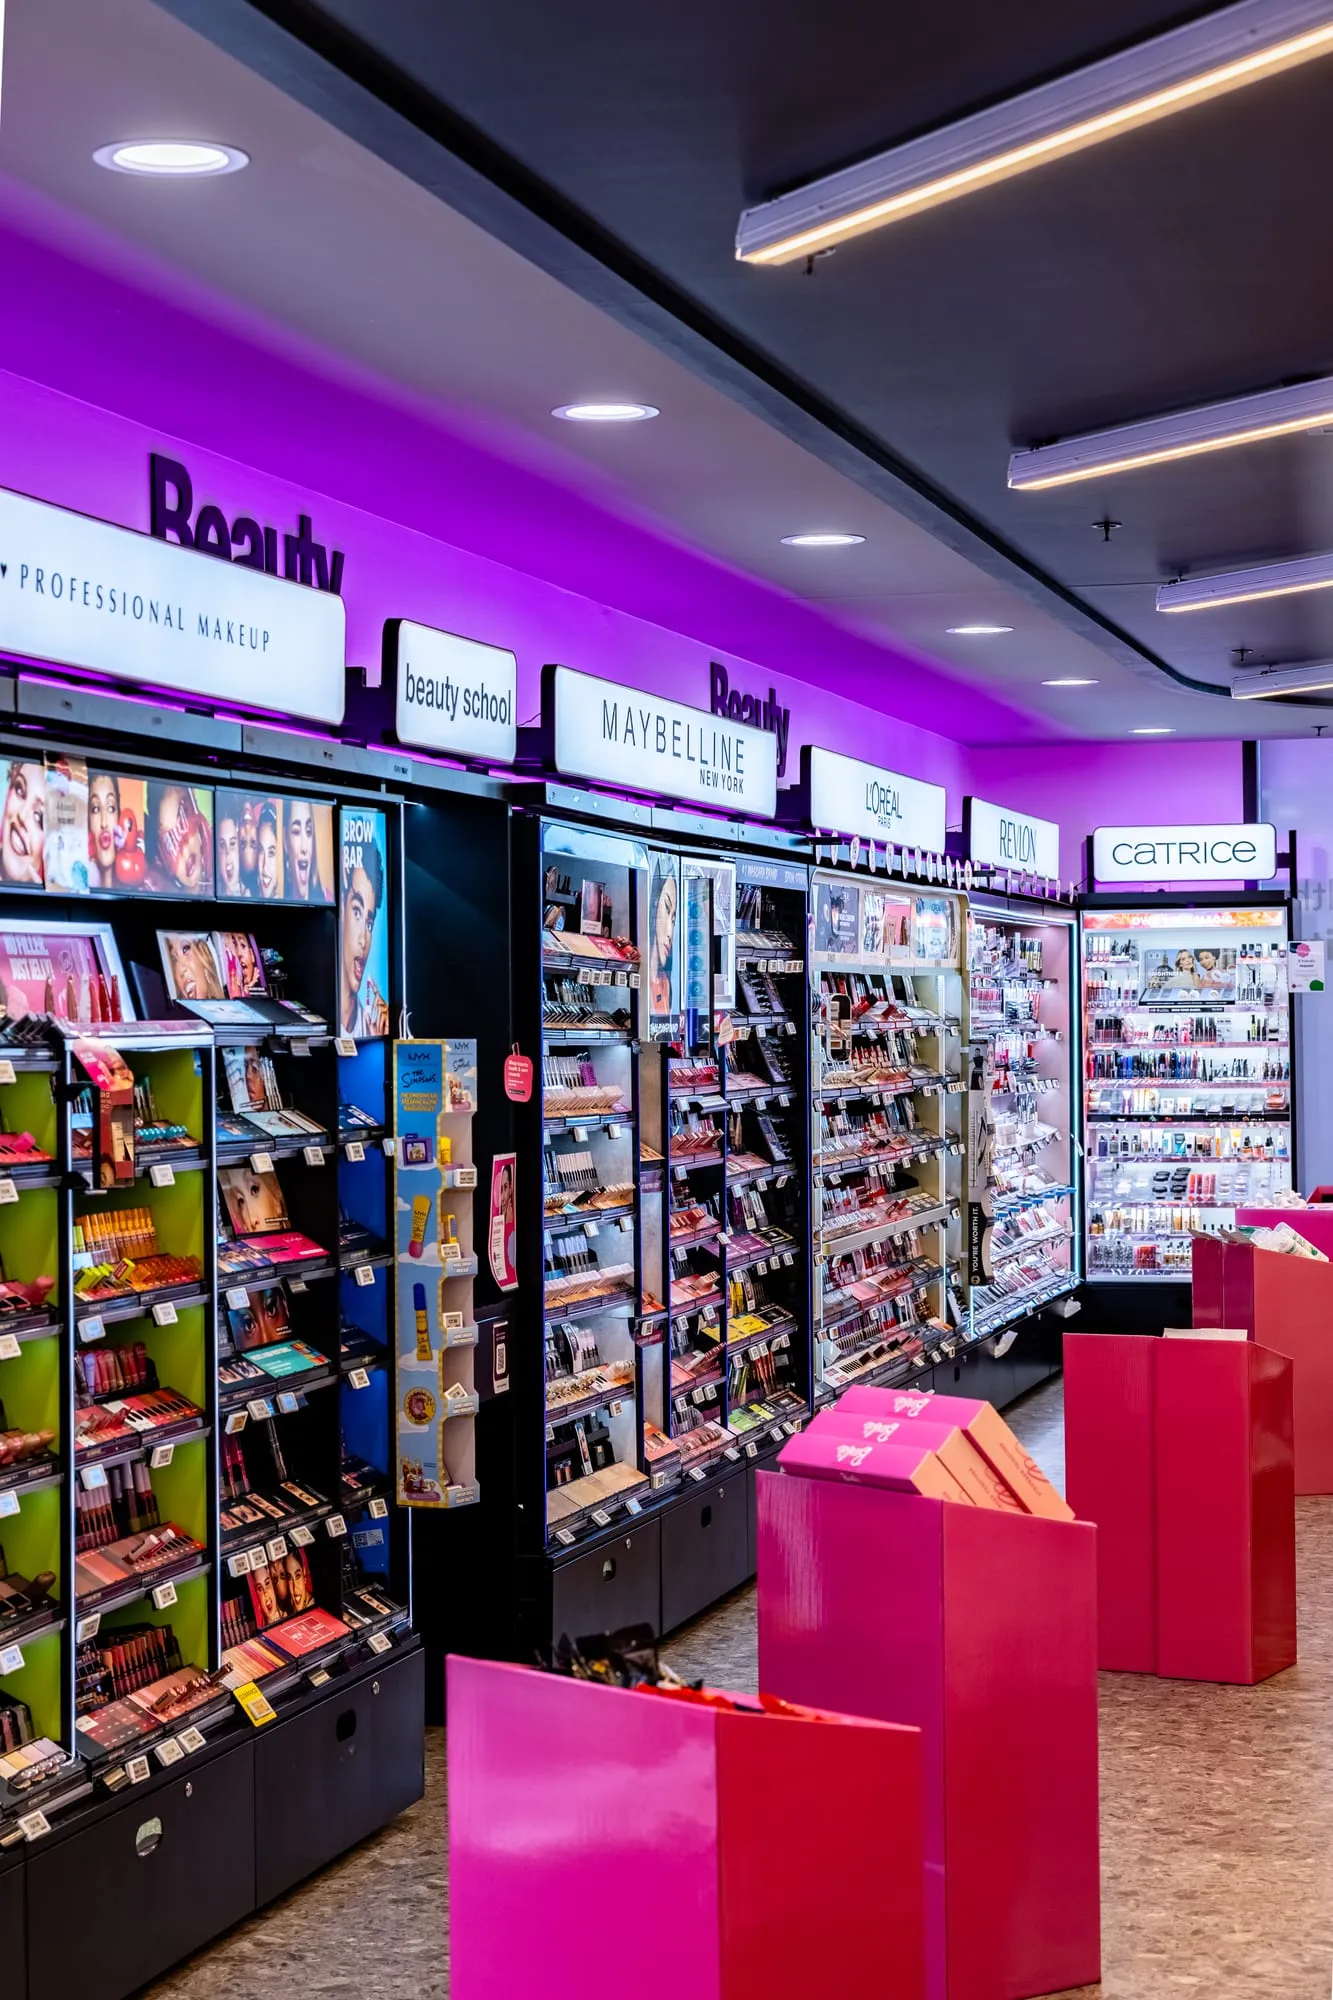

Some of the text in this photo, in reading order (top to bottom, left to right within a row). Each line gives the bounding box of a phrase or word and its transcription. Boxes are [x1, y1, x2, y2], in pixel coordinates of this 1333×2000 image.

[20, 563, 269, 652] PROFESSIONAL MAKEUP
[405, 662, 511, 725] beauty school
[603, 699, 744, 774] MAYBELLINE
[699, 767, 744, 794] NEW YORK
[866, 781, 902, 819] L'ORÉAL
[344, 820, 373, 843] BROW
[1000, 819, 1037, 864] REVLON
[343, 846, 363, 869] BAR
